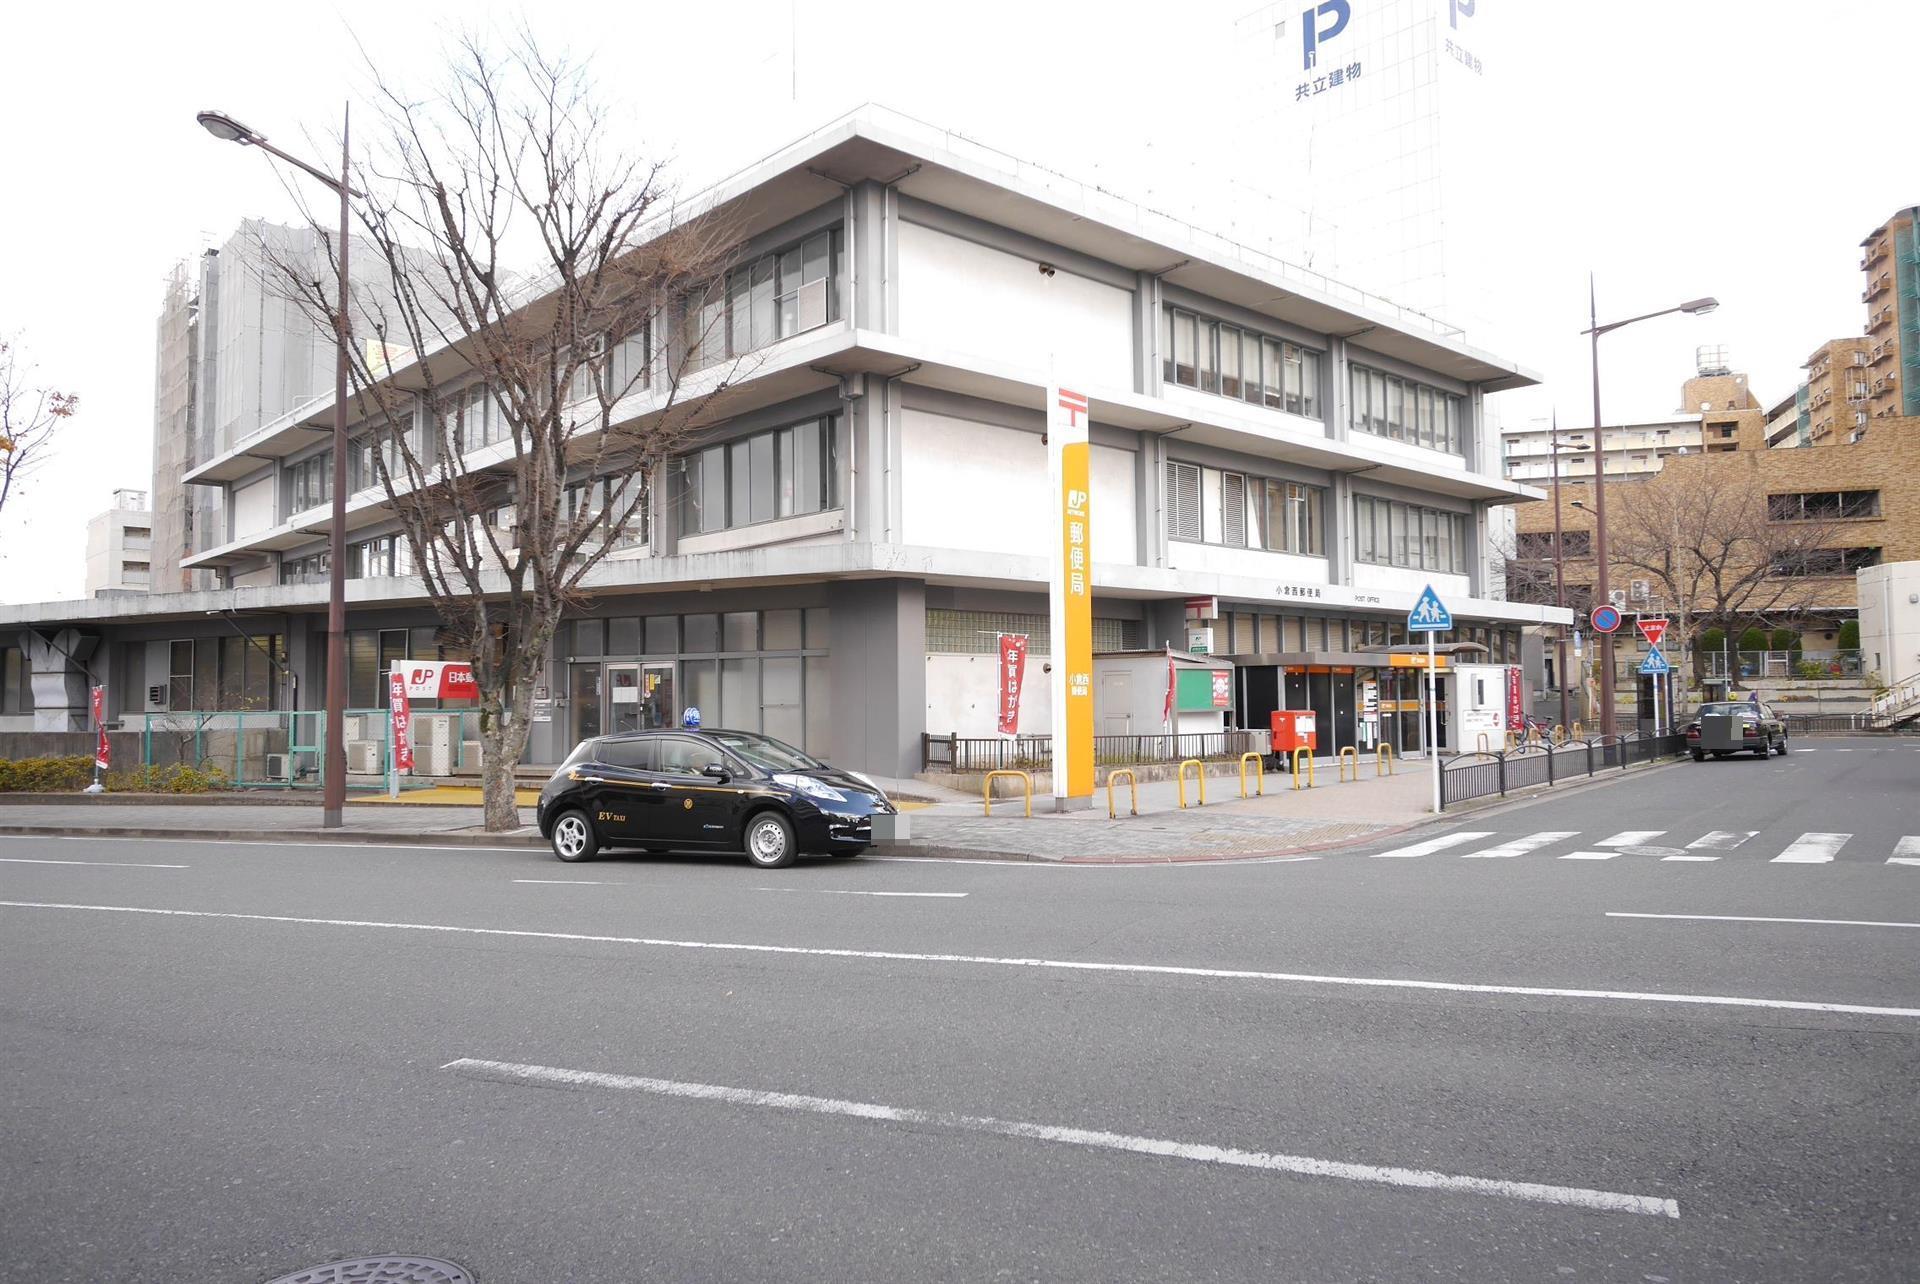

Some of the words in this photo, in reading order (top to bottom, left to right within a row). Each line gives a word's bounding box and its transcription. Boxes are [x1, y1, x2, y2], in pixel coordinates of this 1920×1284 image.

[1445, 38, 1482, 76] 共立建物
[1295, 62, 1362, 101] 共立建物
[1068, 489, 1087, 509] JP
[1070, 521, 1084, 595] 郵便局
[1275, 585, 1321, 598] 小倉西郵便局
[1354, 594, 1366, 602] POST
[1367, 596, 1380, 604] OFFICE
[411, 669, 434, 685] JP
[1007, 649, 1019, 723] 年賀はがき
[598, 811, 613, 821] EV
[613, 814, 626, 822] TAXI
